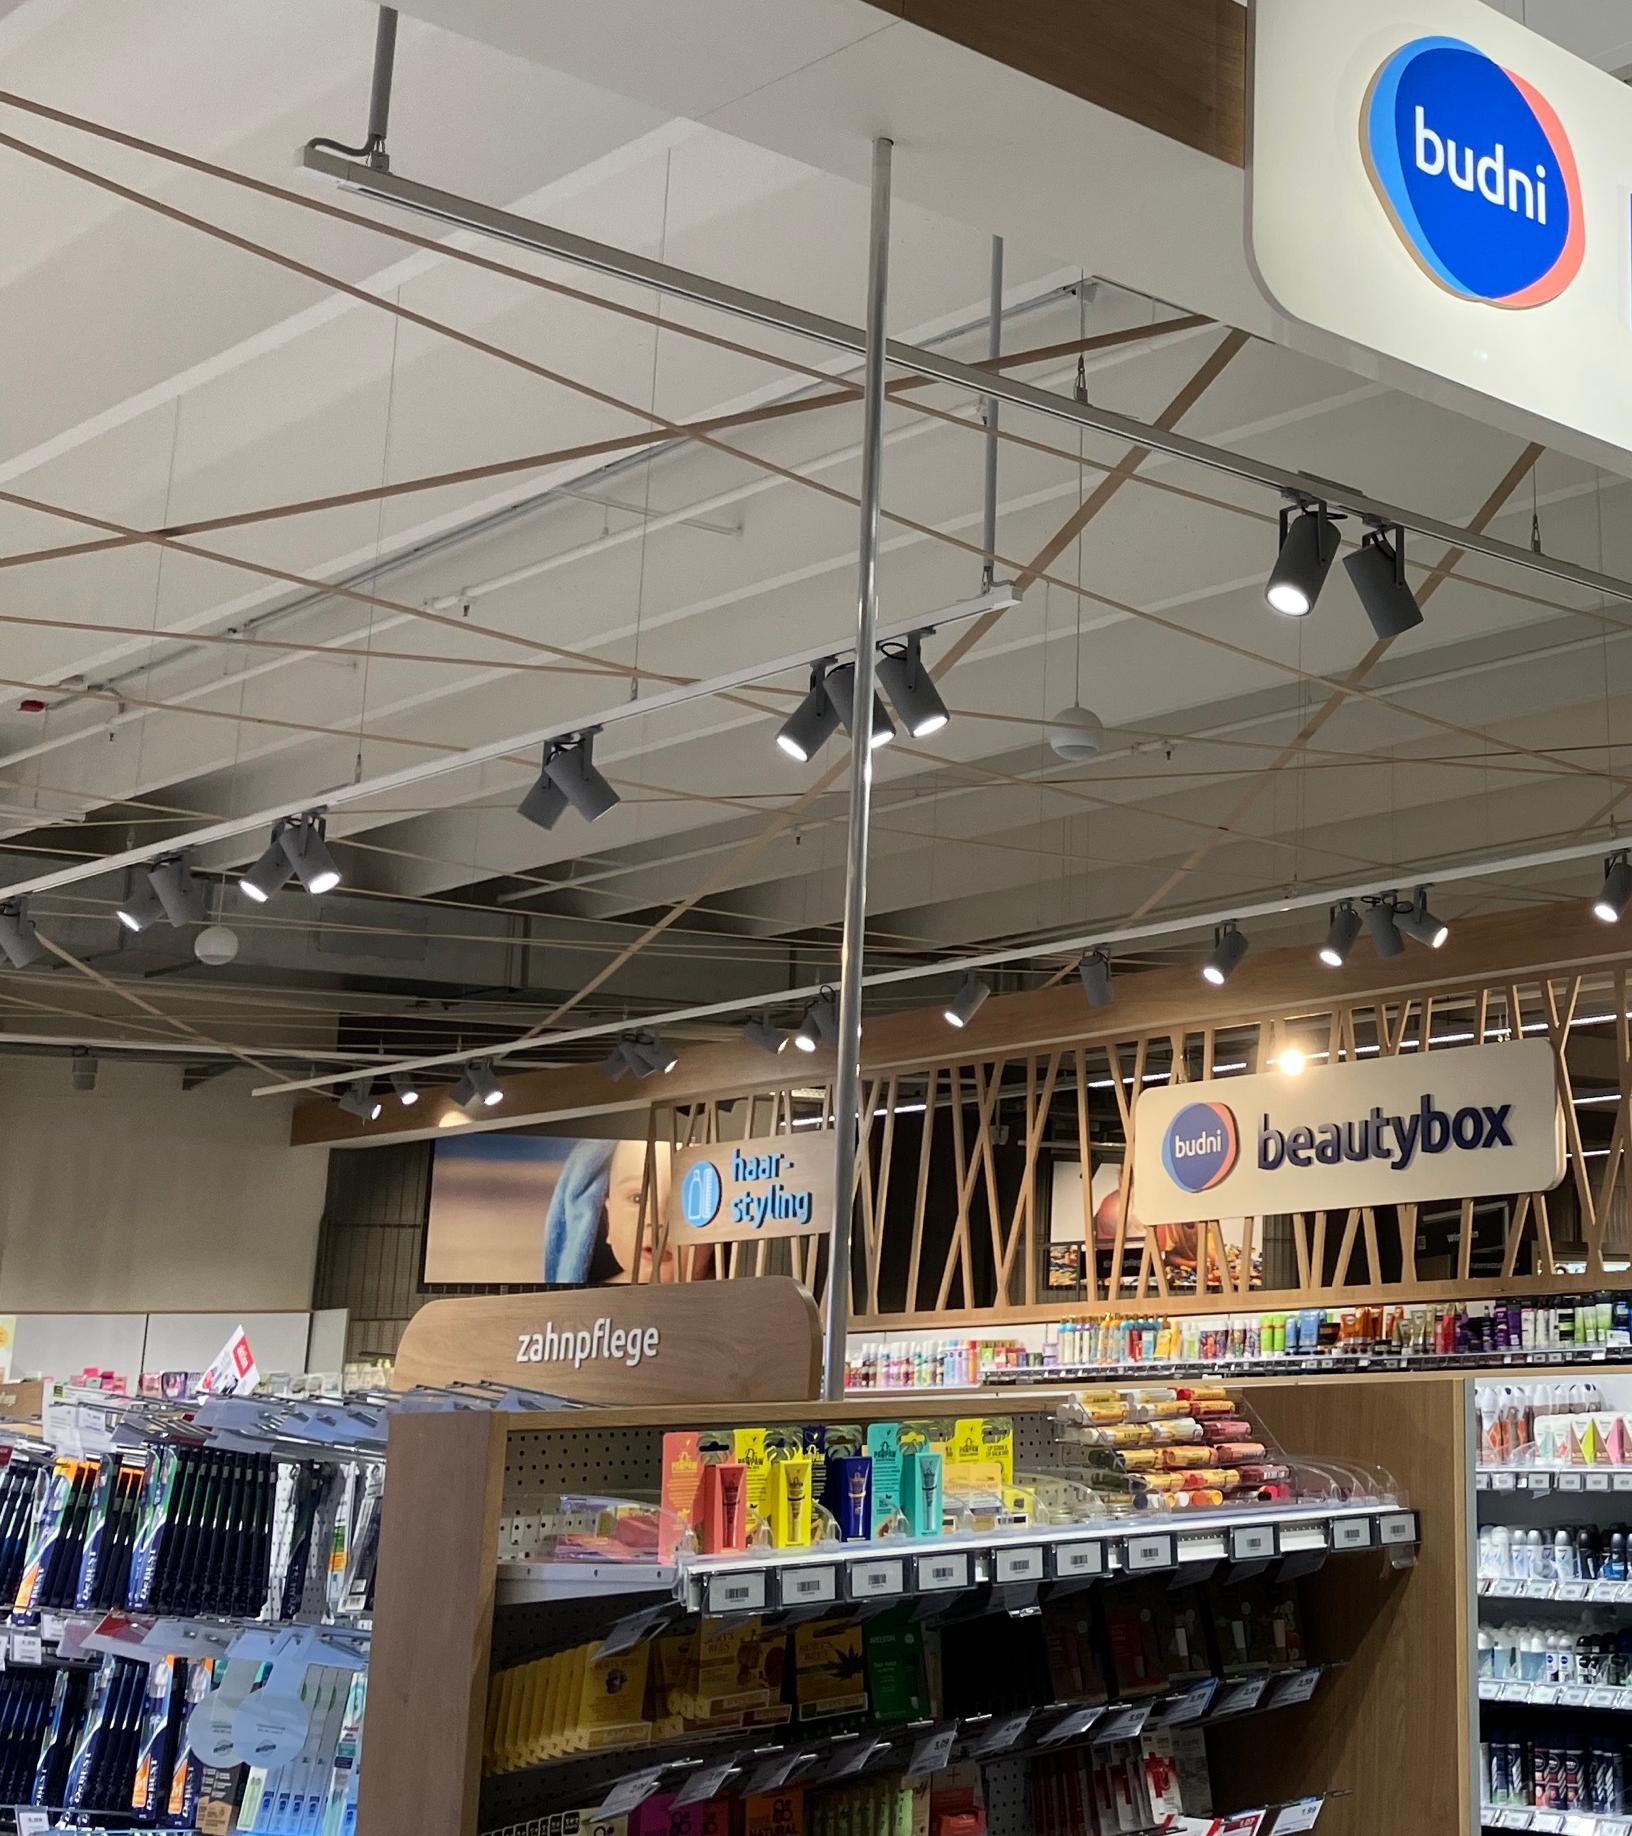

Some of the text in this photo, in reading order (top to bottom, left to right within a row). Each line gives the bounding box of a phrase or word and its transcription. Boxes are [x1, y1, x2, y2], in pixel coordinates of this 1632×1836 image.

[1414, 105, 1548, 225] budni
[1174, 1093, 1513, 1171] budni beautybox
[731, 1149, 794, 1182] haar-
[731, 1184, 812, 1228] styling
[516, 1317, 660, 1369] zahnpflege
